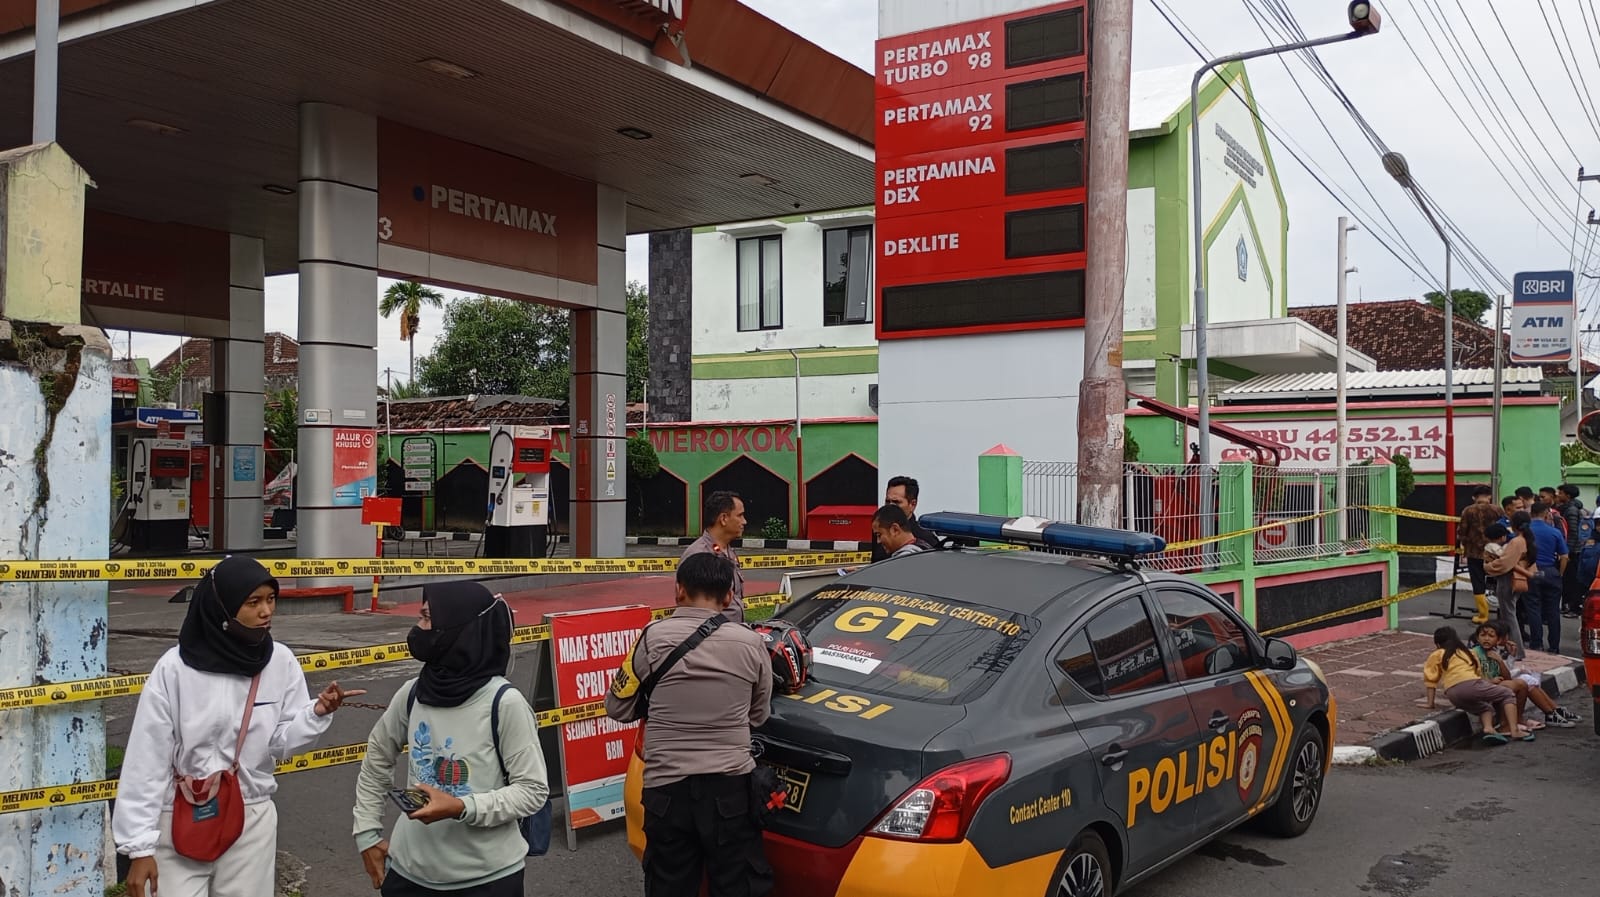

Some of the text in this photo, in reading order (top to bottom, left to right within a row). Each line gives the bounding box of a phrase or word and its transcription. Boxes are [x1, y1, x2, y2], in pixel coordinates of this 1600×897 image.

[884, 31, 992, 66] PERTAMAX
[884, 52, 992, 86] TURBO 98
[884, 93, 993, 126] PERTAMAX
[968, 114, 993, 132] 92
[884, 156, 996, 187] PERTAMINA
[884, 186, 920, 206] DEX
[431, 184, 557, 238] PERTAMAX
[378, 217, 393, 240] 3
[884, 233, 960, 256] DEXLITE
[81, 278, 164, 301] RTALITE
[1539, 280, 1565, 293] BRI
[1521, 316, 1564, 328] ATM
[336, 432, 361, 441] JALUR
[649, 425, 797, 453] MEROKOK
[15, 569, 101, 579] DILARANG MELINTAS
[124, 568, 178, 577] GARIS POLISI
[290, 567, 334, 575] GARIS POLISI
[841, 590, 892, 603] LAYANAN
[886, 595, 948, 615] POLRI-CALL
[949, 606, 1002, 626] CENTER
[997, 620, 1021, 637] 110
[834, 606, 940, 642] GT
[329, 651, 349, 661] GARIS
[350, 649, 371, 659] POLISI
[558, 635, 588, 664] MAAF
[820, 650, 869, 664] MASYARAKAT
[828, 643, 875, 658] POLRI UNTUK
[18, 687, 46, 698] POLISI
[71, 680, 111, 693] DILARANG
[576, 669, 606, 699] SPBU
[1, 700, 20, 708] POLICE
[784, 688, 895, 720] ISI
[565, 718, 597, 741] SEDANG
[312, 748, 345, 761] DILARANG
[605, 739, 624, 760] BBM
[70, 781, 118, 795] GARIS POLI
[1127, 731, 1236, 829] POLISI
[2, 790, 46, 803] MELINTAS
[82, 793, 100, 801] POLICE
[1010, 788, 1071, 824] Contact Center 110
[2, 803, 20, 811] CROSS
